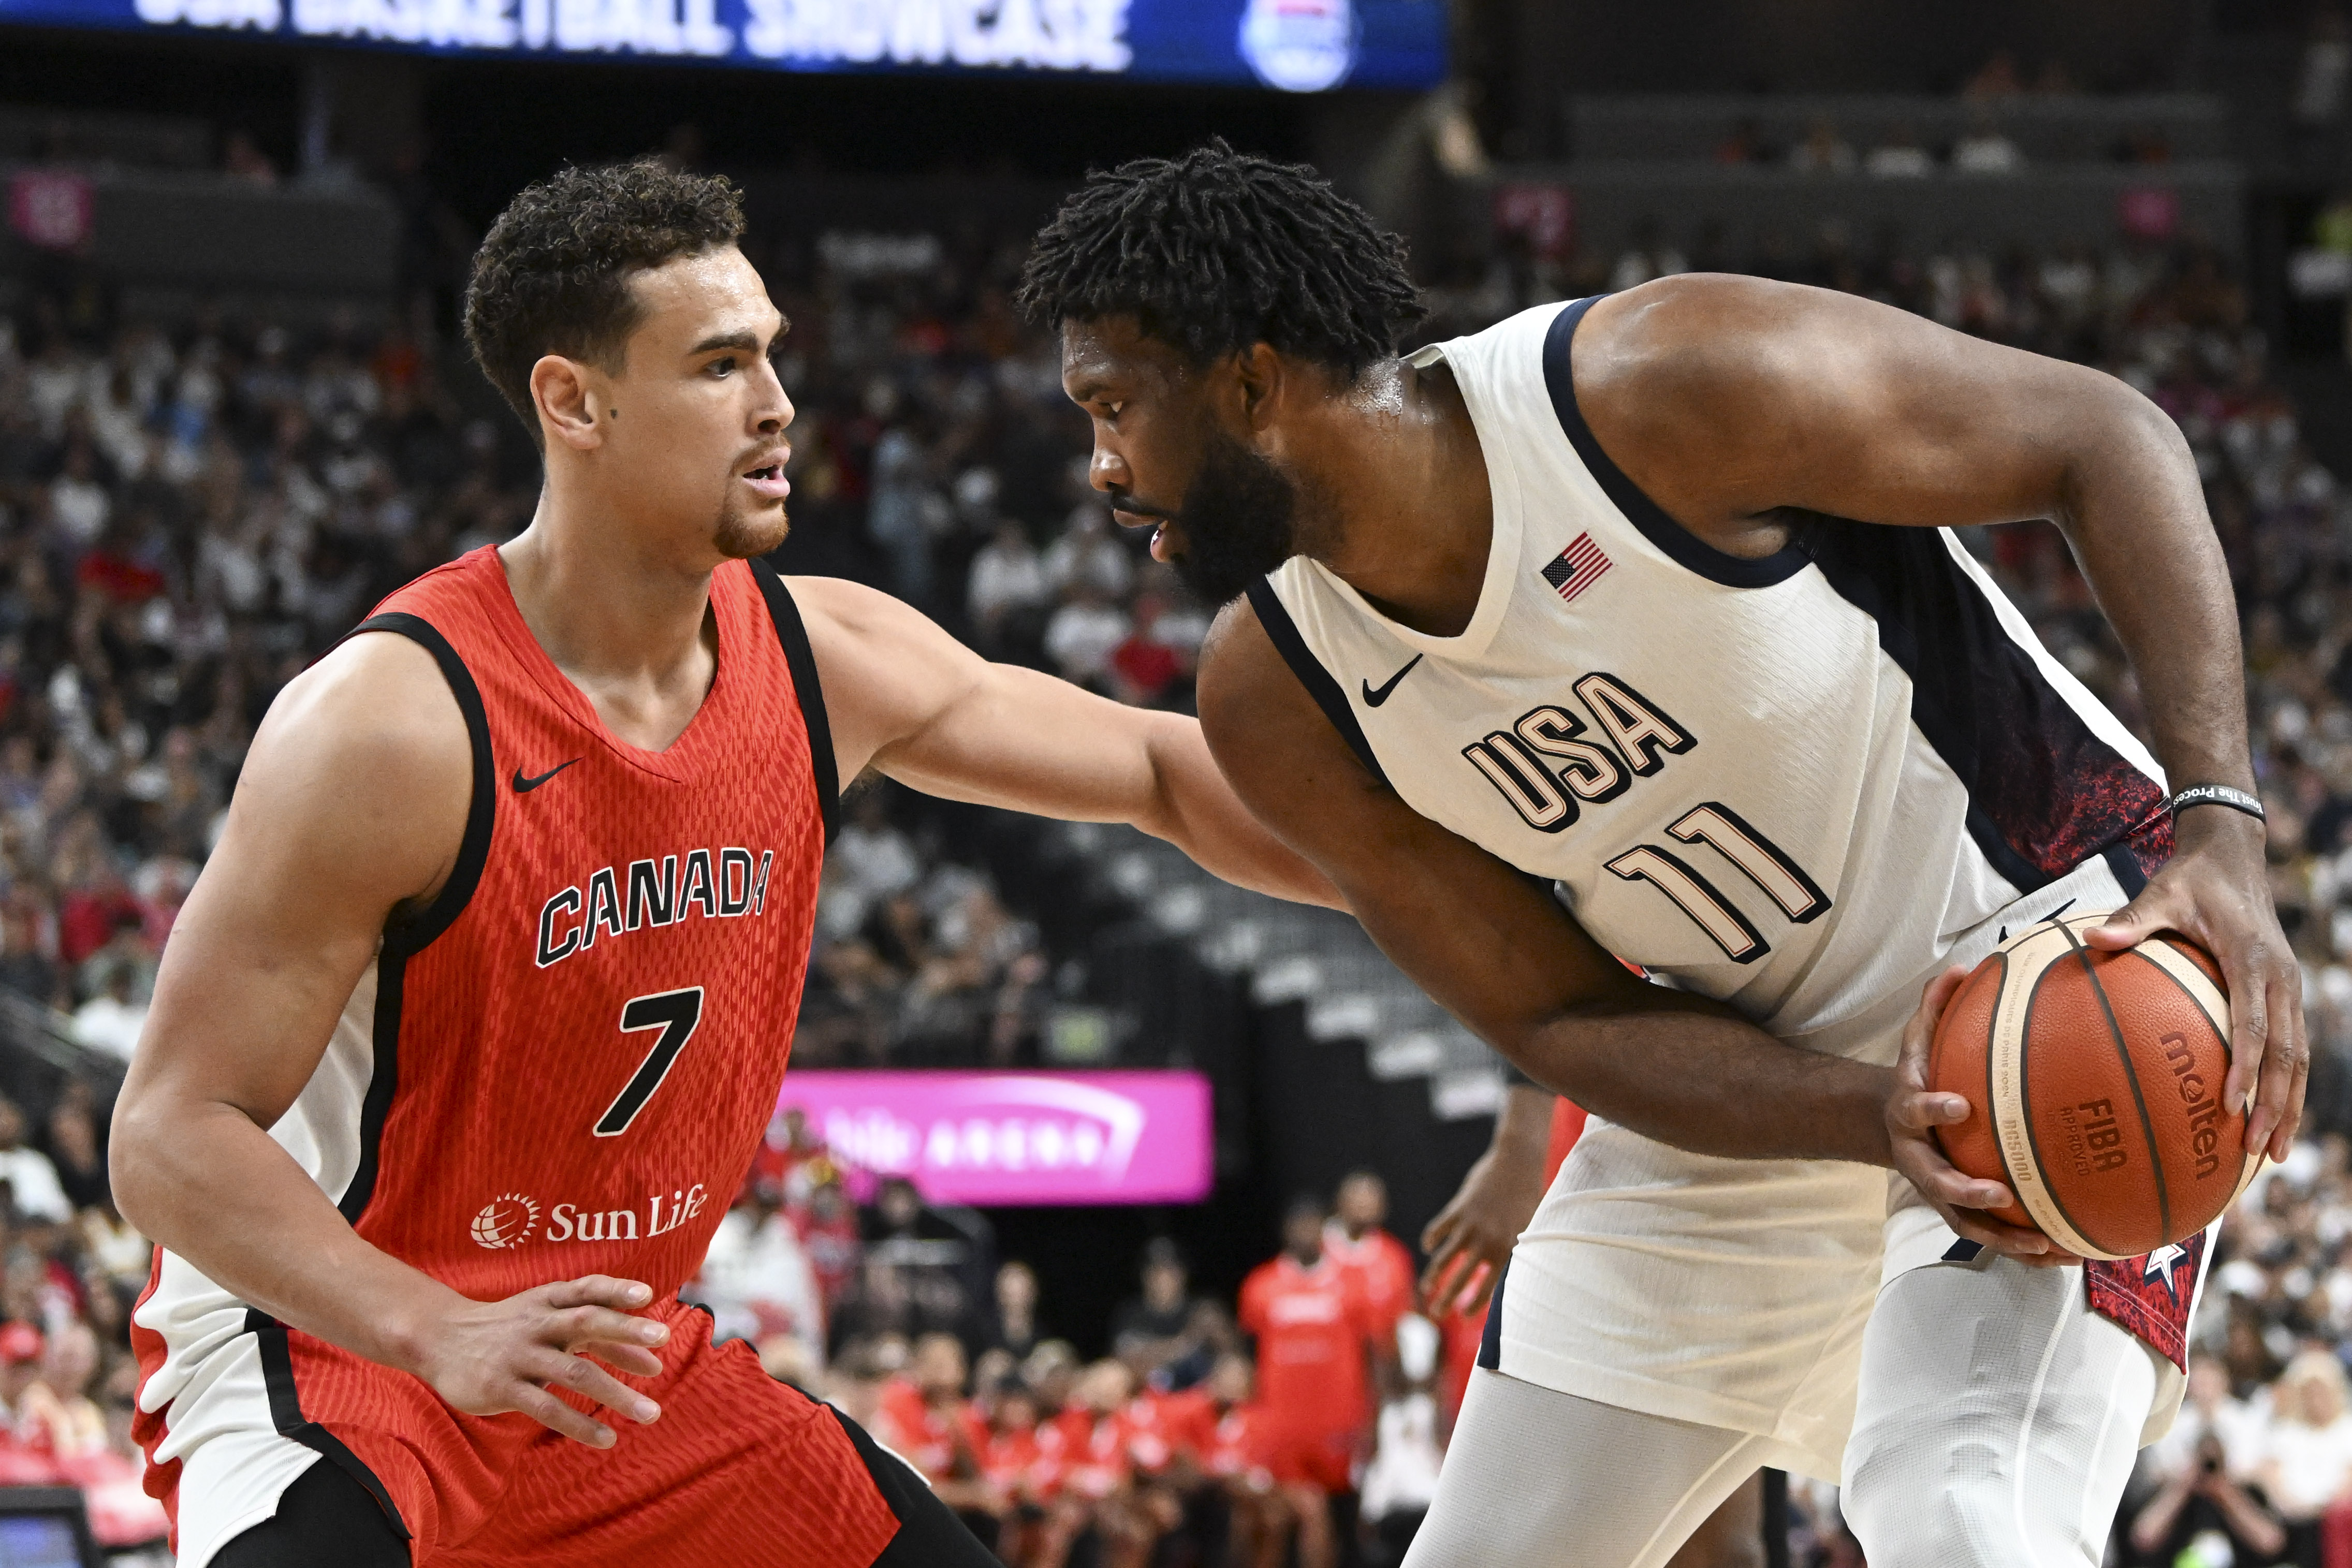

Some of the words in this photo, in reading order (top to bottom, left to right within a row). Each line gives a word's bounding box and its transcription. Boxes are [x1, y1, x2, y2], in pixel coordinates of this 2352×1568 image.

[1460, 671, 1698, 834] USA
[2173, 787, 2215, 808] Proces
[2218, 787, 2240, 803] The
[2241, 794, 2263, 815] Trust
[535, 847, 774, 969] CANADA
[1602, 801, 1833, 965] 11
[593, 985, 704, 1137] 7
[2001, 1071, 2010, 1098] 2024
[2002, 1039, 2010, 1068] PARIS
[2059, 1106, 2092, 1177] APPROVED
[2078, 1098, 2127, 1173] FIBA
[2160, 1031, 2219, 1181] molten
[546, 1203, 639, 1242] Sun
[646, 1183, 708, 1238] Life
